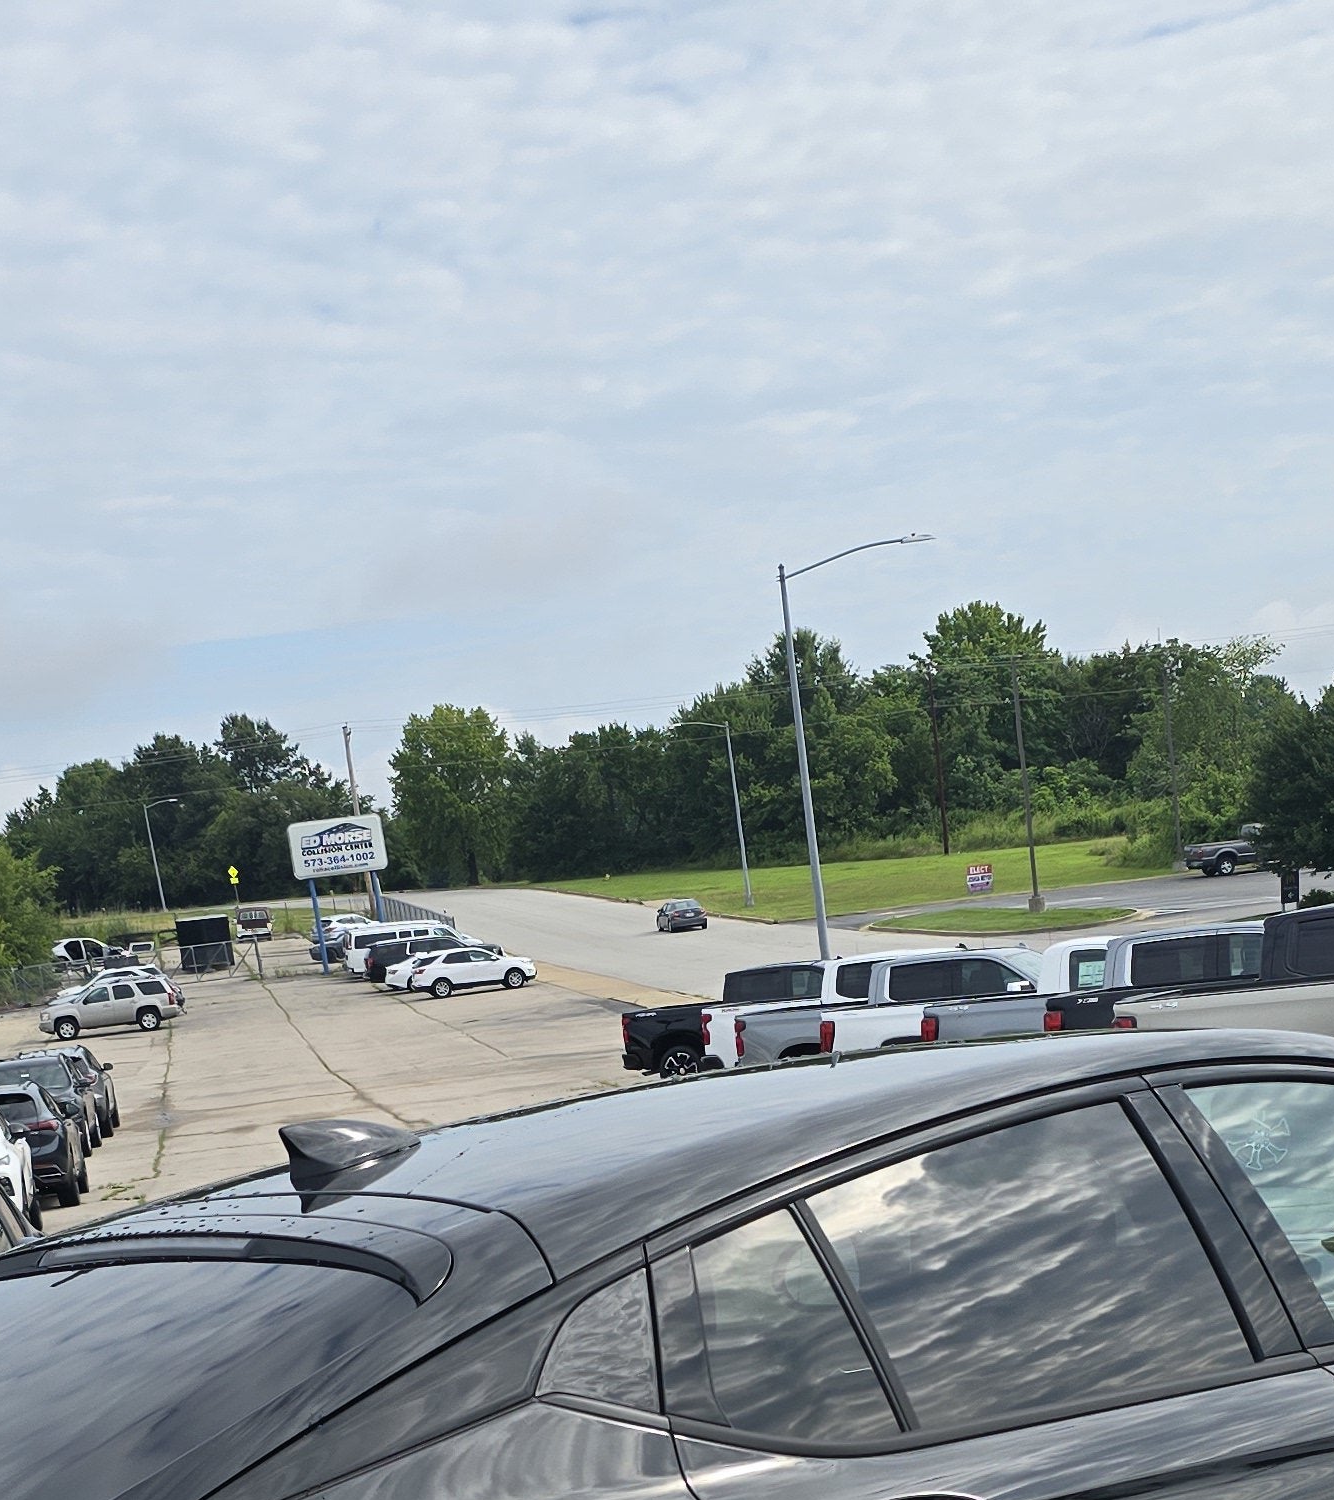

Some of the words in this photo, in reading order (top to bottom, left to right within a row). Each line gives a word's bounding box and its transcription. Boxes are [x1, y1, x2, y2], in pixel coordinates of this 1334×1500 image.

[301, 836, 321, 849] ED
[322, 828, 372, 846] MORSE
[301, 845, 343, 857] COLLISION
[344, 842, 373, 851] CENTER
[303, 851, 375, 868] 573-364-1002
